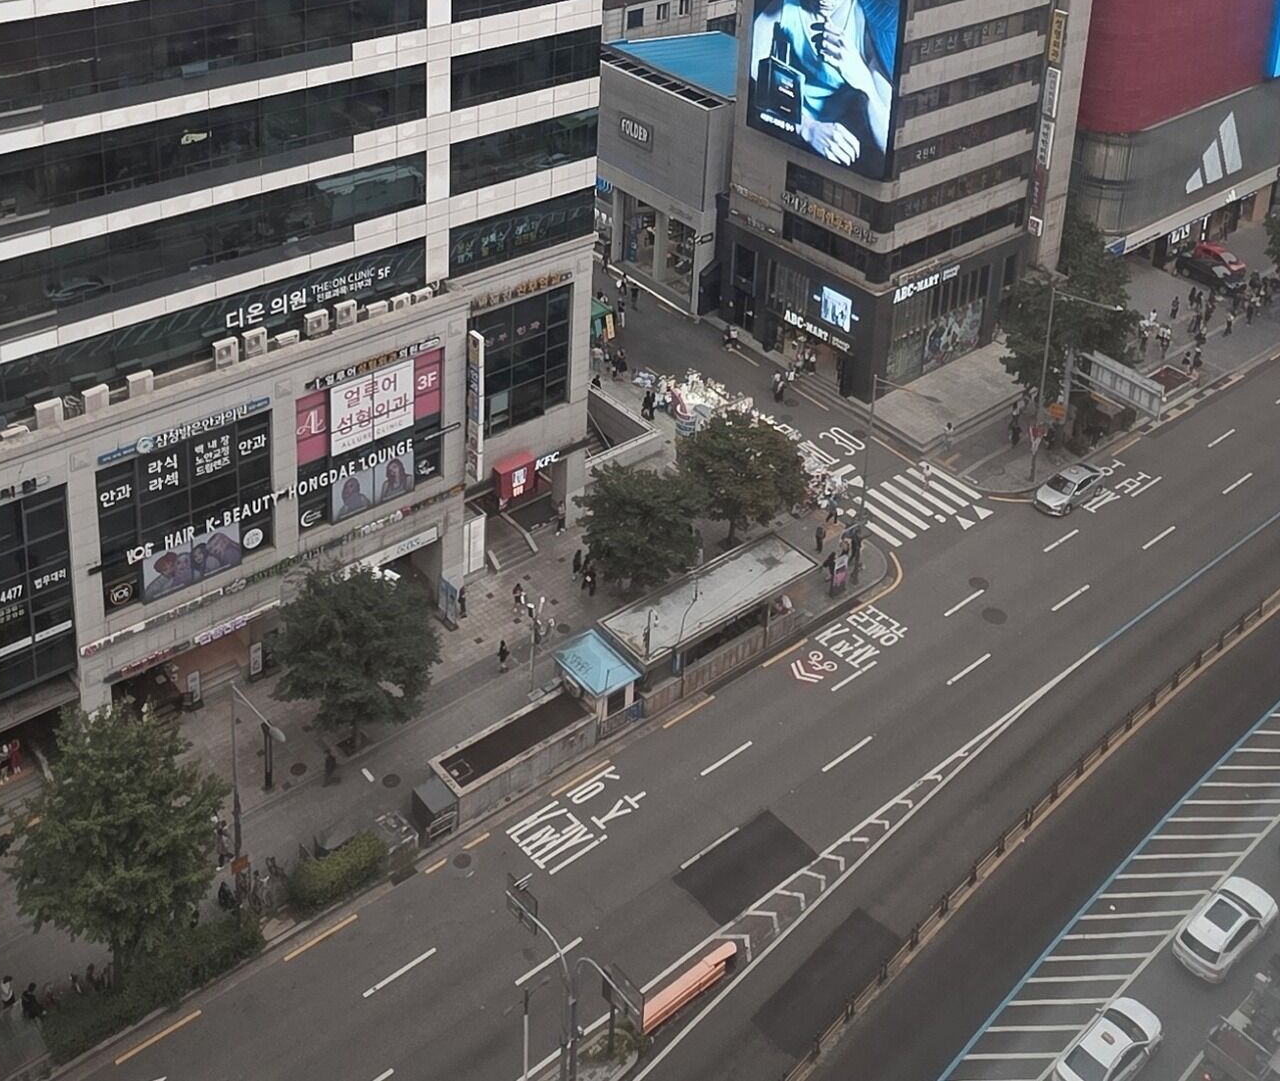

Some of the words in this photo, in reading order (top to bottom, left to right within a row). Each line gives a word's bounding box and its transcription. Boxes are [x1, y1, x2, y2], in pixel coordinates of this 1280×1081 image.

[621, 118, 649, 142] FOLDER
[347, 267, 376, 283] CLINIC
[377, 266, 391, 280] 5F
[892, 273, 940, 305] ABC-MART
[225, 302, 266, 328] 디온
[270, 288, 307, 315] 의원
[783, 309, 829, 343] ABC-MART
[344, 373, 399, 408] 얼루어
[417, 371, 438, 390] 3F
[337, 393, 410, 436] 성형외과
[238, 434, 267, 456] 안과
[147, 453, 179, 475] 라식
[535, 451, 561, 471] KFC
[148, 471, 179, 492] 라섹
[100, 484, 133, 508] 안과
[164, 525, 195, 551] HAIR
[205, 492, 280, 534] K-BEAUTY
[288, 461, 356, 500] HONGDAE
[845, 604, 909, 647] 우선도로
[814, 622, 881, 669] 자전거
